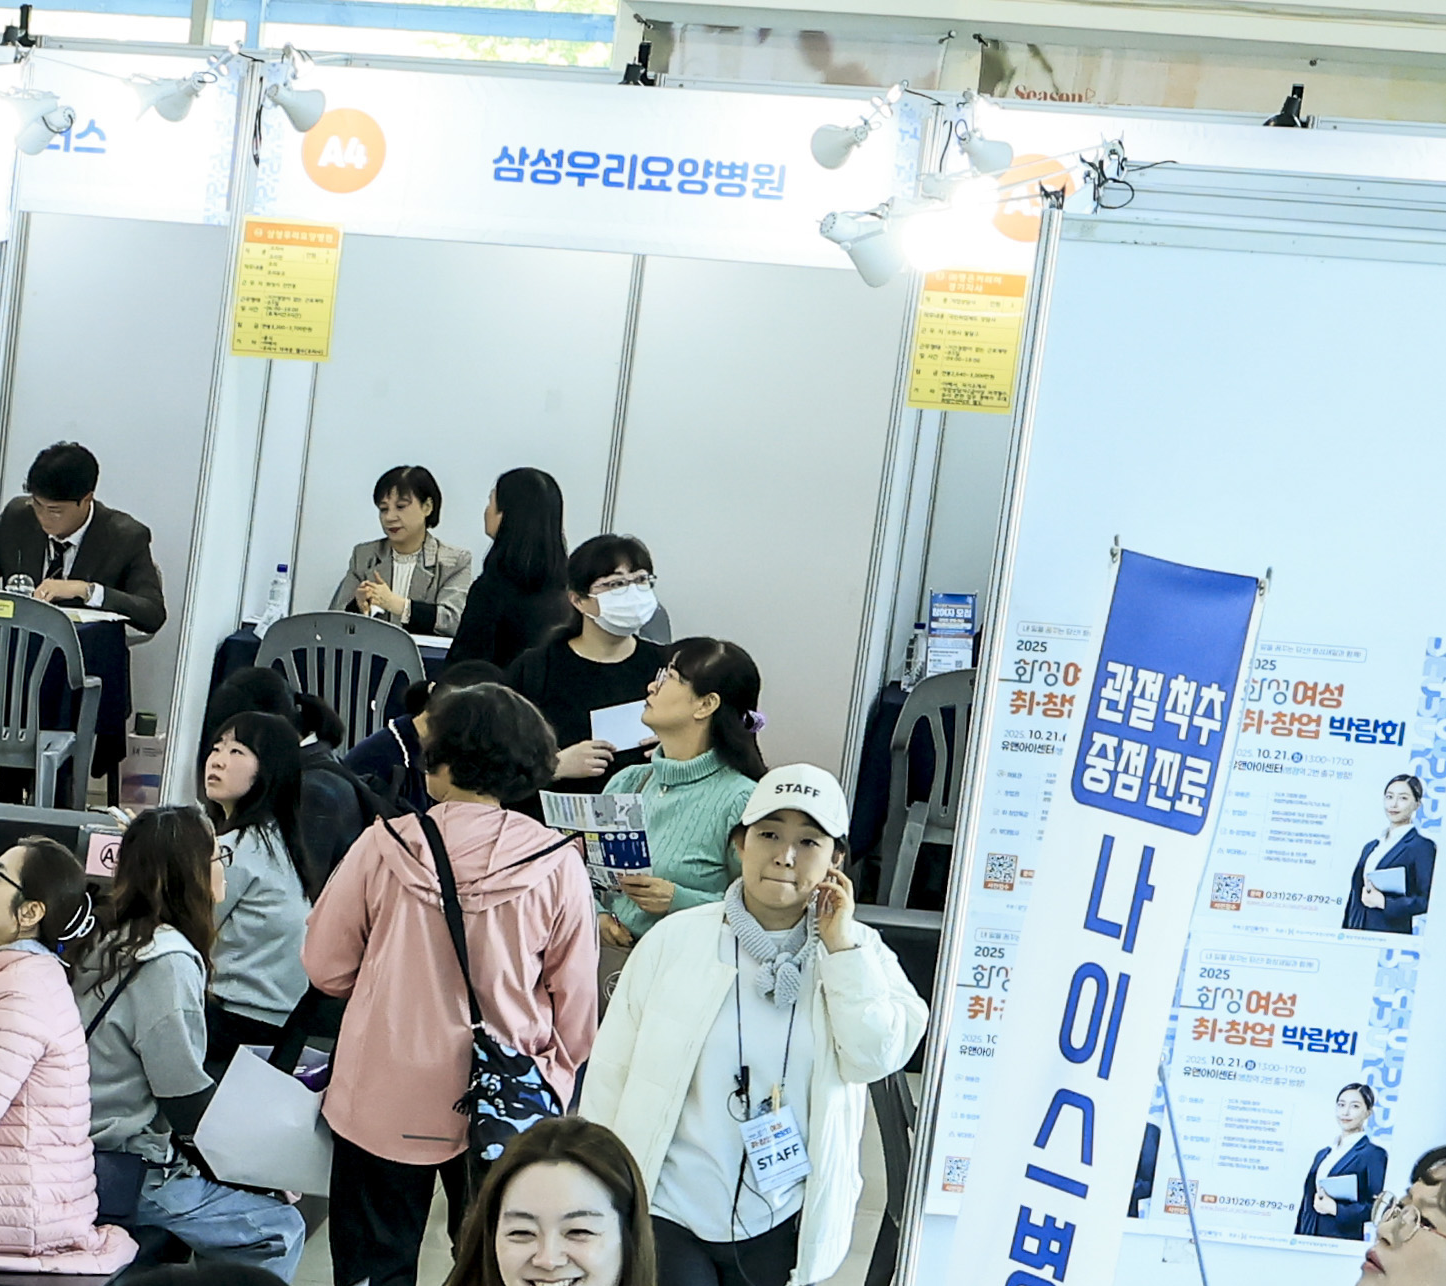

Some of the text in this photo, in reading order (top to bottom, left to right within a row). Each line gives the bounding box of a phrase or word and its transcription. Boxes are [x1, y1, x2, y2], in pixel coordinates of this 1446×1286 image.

[318, 138, 367, 169] A4
[492, 143, 786, 202] 삼성우리요양병원
[1017, 640, 1047, 653] 2025
[1097, 661, 1227, 747] 관절 척추
[1329, 715, 1406, 746] 박람회
[1081, 731, 1213, 817] 중점 진료
[775, 783, 820, 797] STAFF
[974, 945, 1005, 959] 2025
[1199, 967, 1230, 980] 2025
[1282, 1025, 1358, 1055] 박람회
[757, 1143, 800, 1171] STAFF
